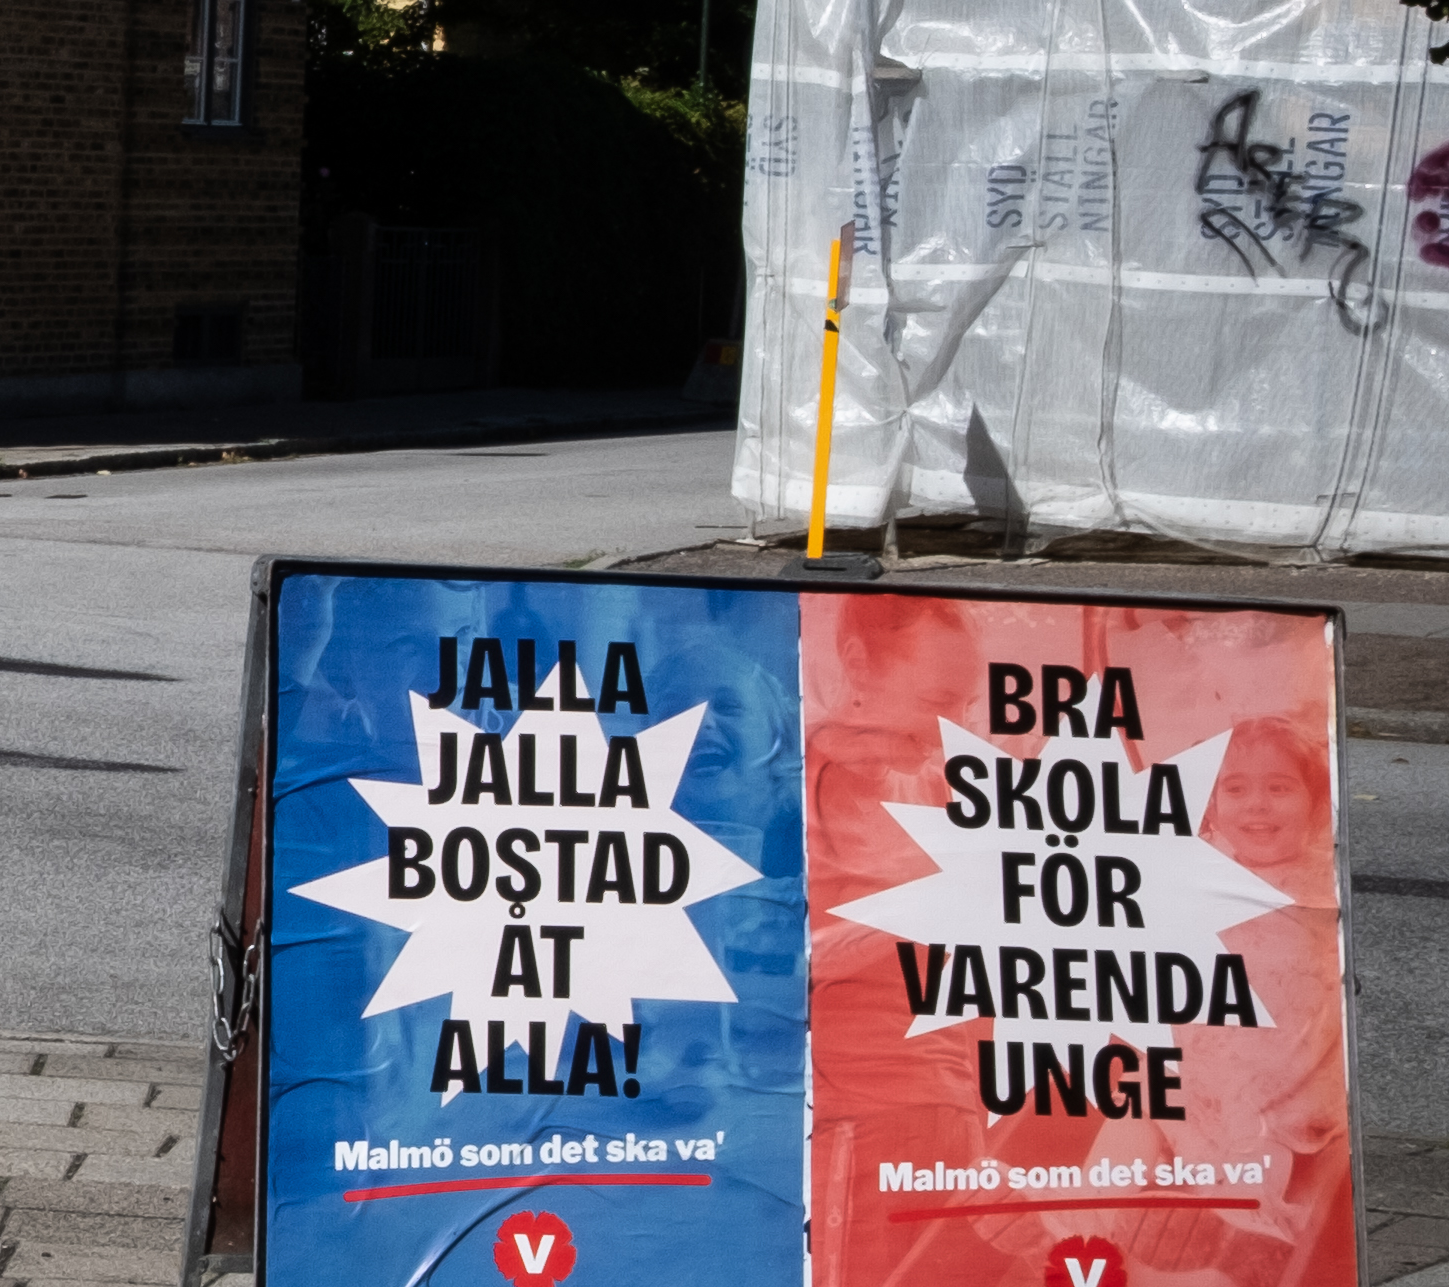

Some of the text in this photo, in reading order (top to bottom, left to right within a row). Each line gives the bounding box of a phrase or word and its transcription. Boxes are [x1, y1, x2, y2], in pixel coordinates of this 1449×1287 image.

[986, 164, 1027, 229] SYD
[427, 636, 650, 716] JALLA
[987, 661, 1145, 741] BRA
[427, 731, 651, 810] JALLA
[943, 754, 1193, 837] SKOLA
[387, 825, 691, 906] BOSTAD
[1000, 833, 1146, 929] FÖR
[490, 900, 585, 999] ÅT
[895, 941, 1259, 1029] VARENDA
[429, 1018, 642, 1100] ALLA!
[977, 1039, 1187, 1122] UNGE
[334, 1130, 726, 1171] Malmö som det ska va'
[878, 1155, 1272, 1192] Malmö som det ska va'
[513, 1233, 556, 1275] V
